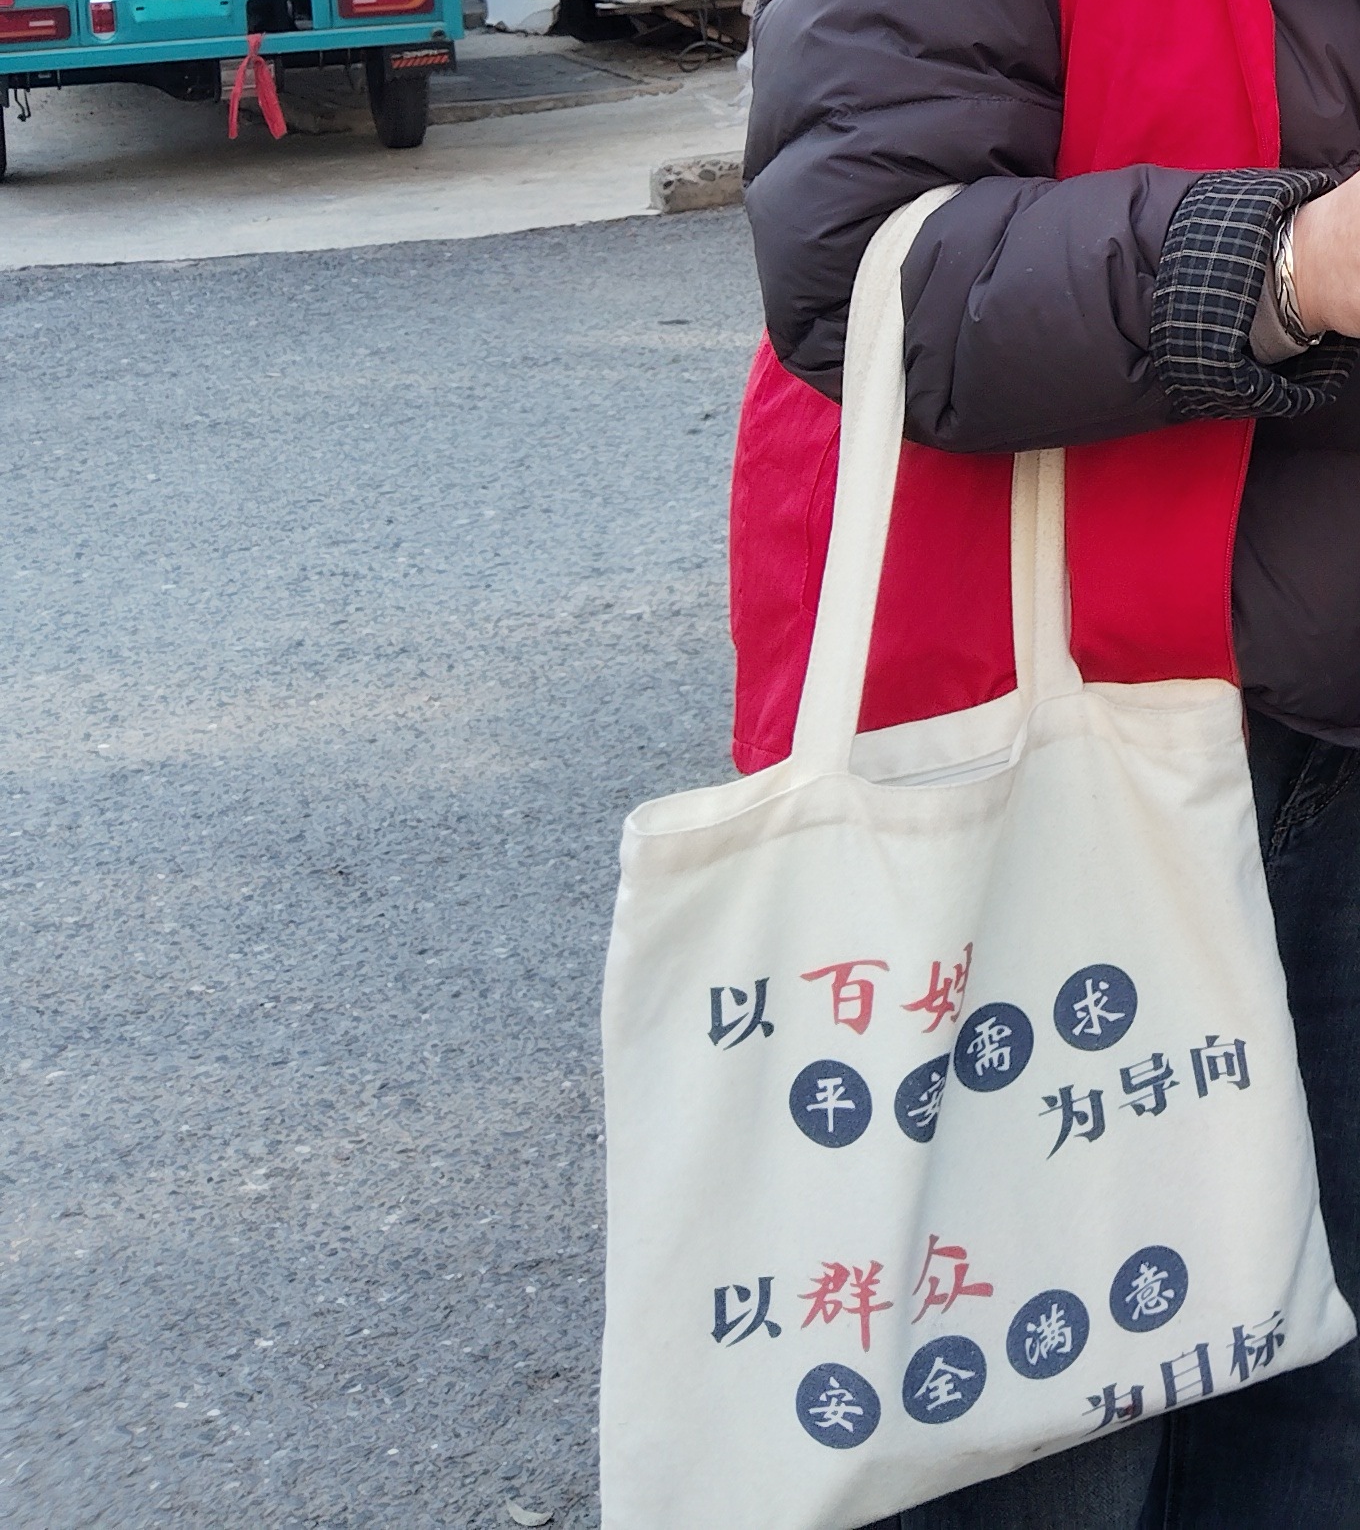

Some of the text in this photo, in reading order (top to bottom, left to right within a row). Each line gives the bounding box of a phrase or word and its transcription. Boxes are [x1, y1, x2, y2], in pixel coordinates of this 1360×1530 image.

[1038, 1033, 1254, 1162] 为导向
[711, 1233, 995, 1354] 以群众
[808, 1262, 1174, 1434] 安全满意
